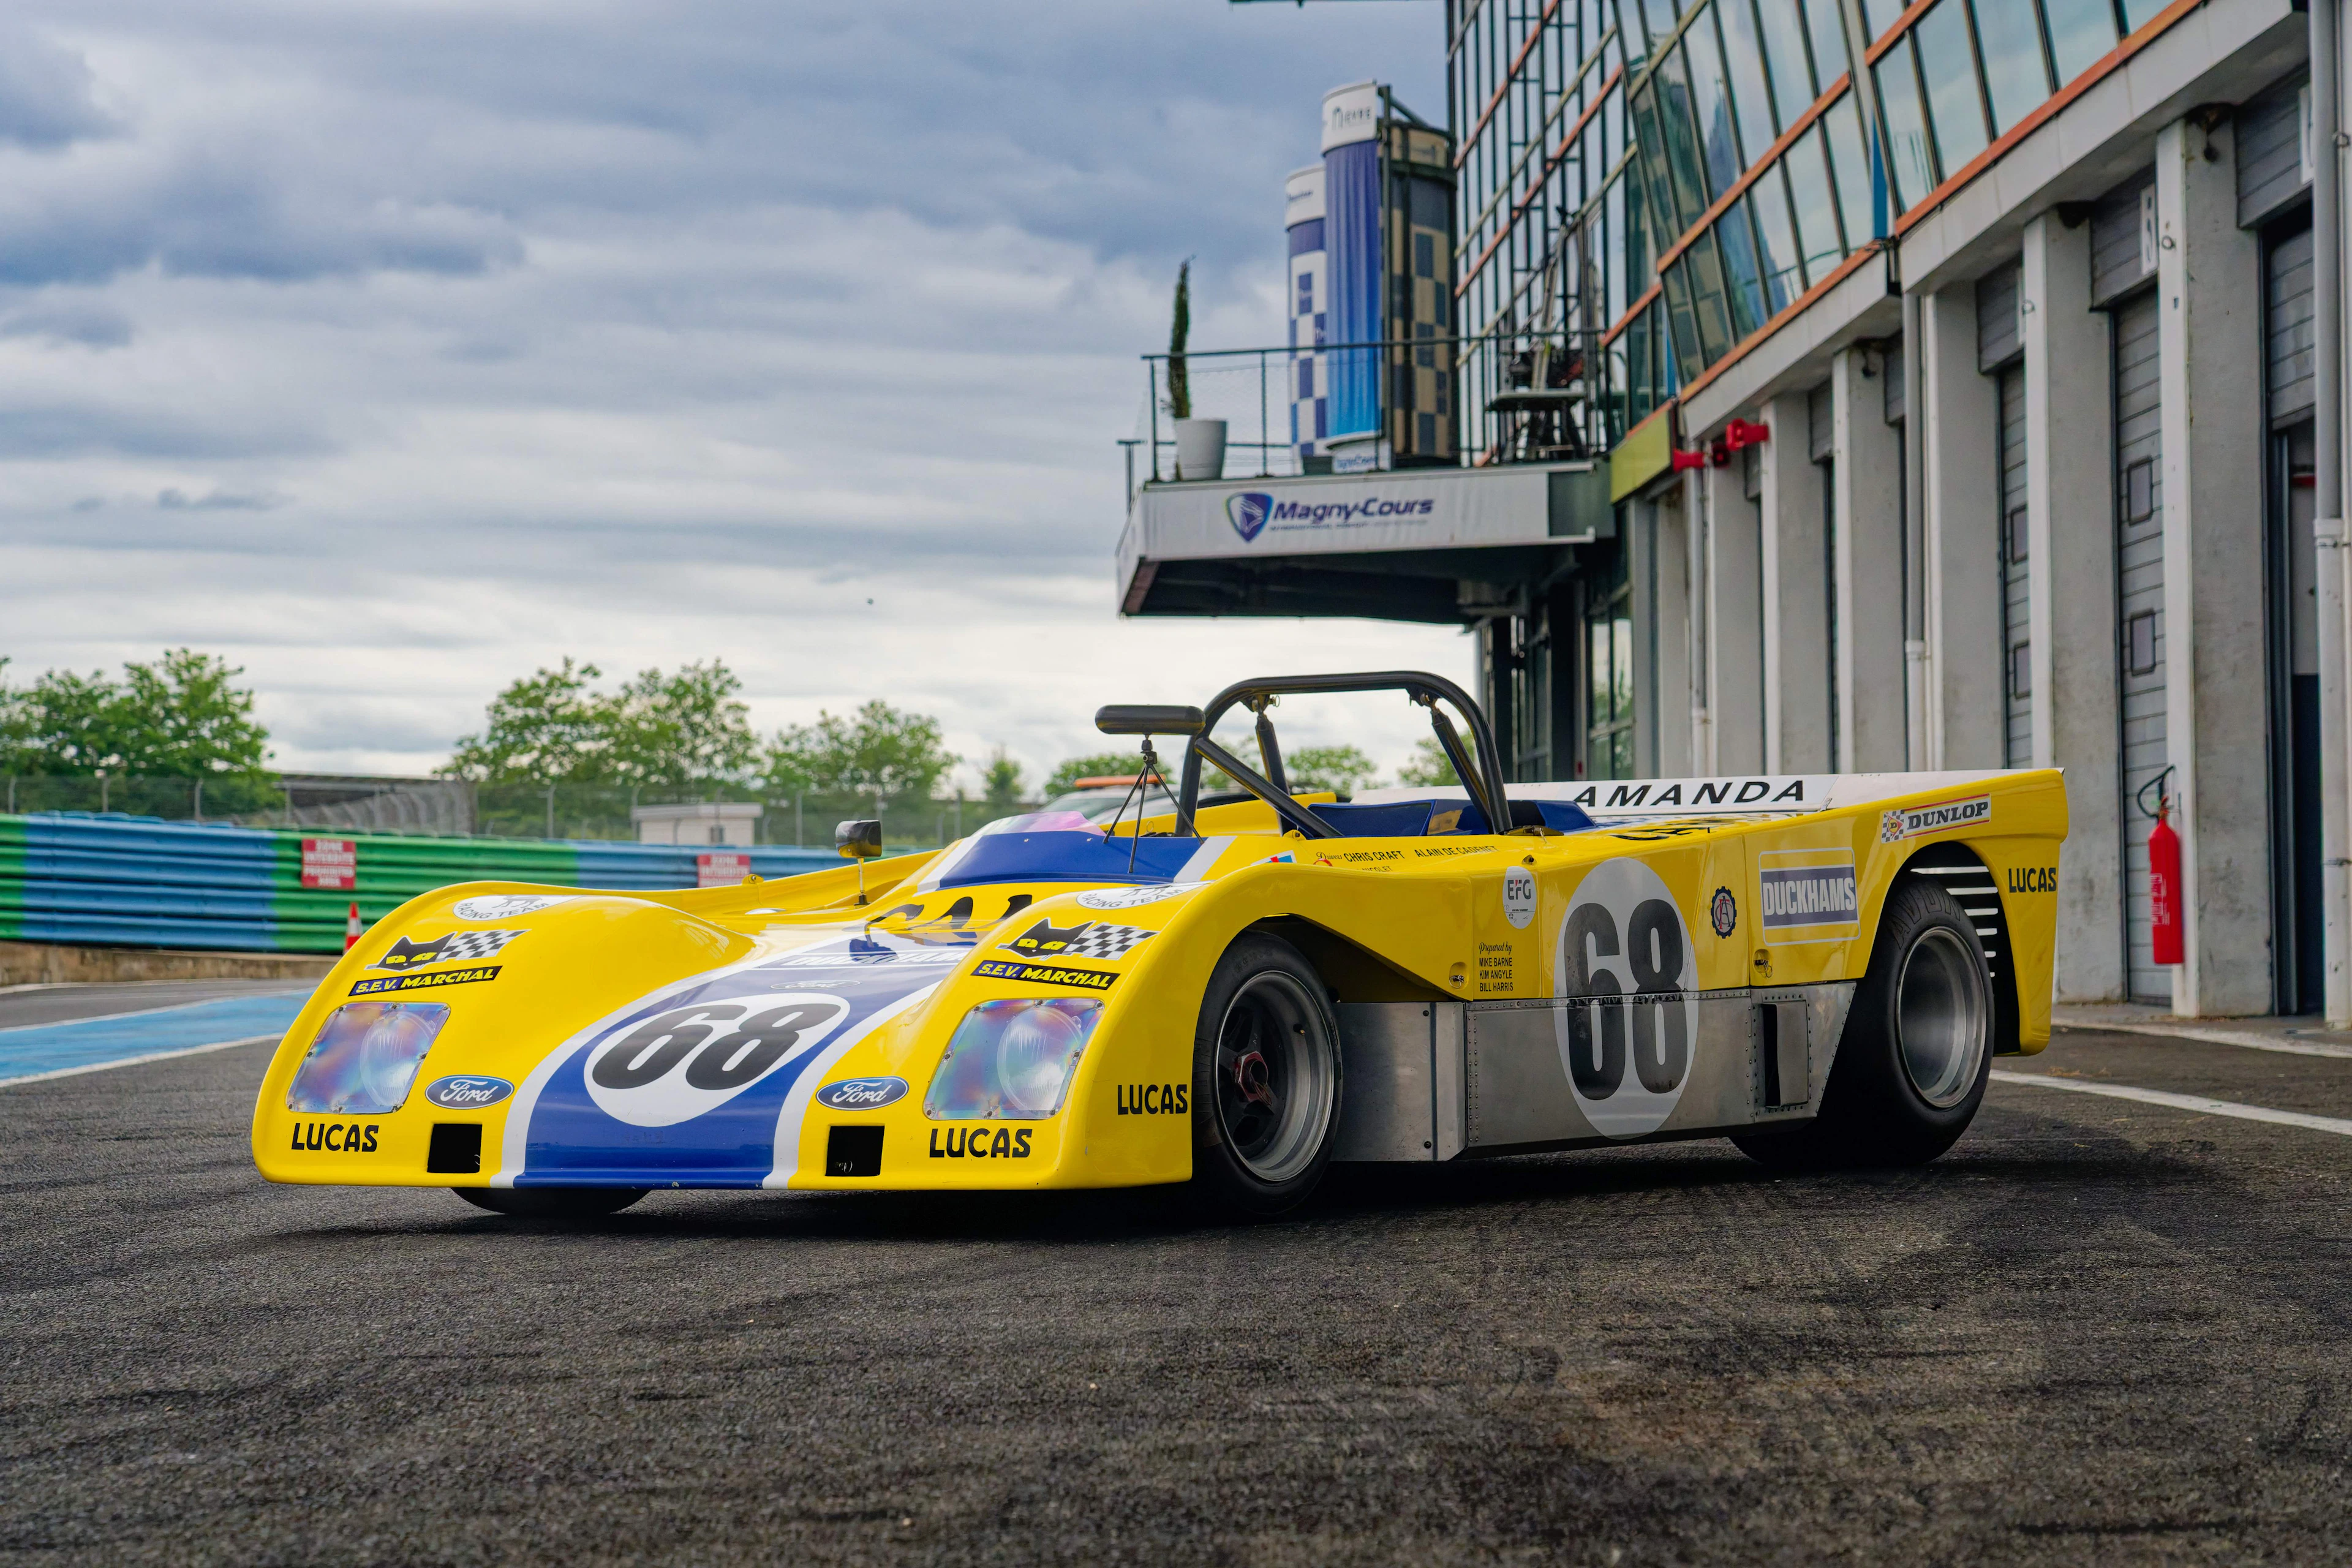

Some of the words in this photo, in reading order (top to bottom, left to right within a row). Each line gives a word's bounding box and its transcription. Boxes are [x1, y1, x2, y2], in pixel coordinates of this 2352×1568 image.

[1574, 780, 1804, 807] AMANDA
[1907, 801, 1989, 831] DUNLOP
[1316, 851, 1343, 861] Drivers
[1343, 852, 1374, 862] CHRIS
[1373, 850, 1405, 861] CRAFT
[1414, 848, 1444, 858] ALAIN
[1455, 846, 1500, 854] CADENET
[1507, 879, 1531, 900] EFG
[2008, 867, 2057, 894] LUCAS
[1082, 893, 1123, 908] RACING
[1129, 889, 1183, 906] TEAM
[1762, 877, 1856, 917] DUCKHAMS
[458, 902, 493, 919] RACING
[498, 902, 550, 918] TEAM
[780, 952, 967, 966] DUCKHAM
[1479, 941, 1505, 955] Prepared
[1505, 941, 1512, 956] by
[1479, 957, 1493, 967] MIKE
[1494, 957, 1512, 967] BARNE
[356, 979, 397, 993] S.E.V.
[399, 969, 494, 989] MARCHAL
[785, 980, 846, 989] Ford
[979, 963, 1020, 978] S.E.V.
[1020, 968, 1110, 987] MARCHAL
[1480, 970, 1490, 979] KIM
[1490, 970, 1513, 979] ANGYLE
[1480, 982, 1492, 992] BILL
[1493, 982, 1513, 992] HARRIS
[1563, 899, 1688, 1101] 68
[592, 1002, 842, 1090] 68
[440, 1079, 499, 1102] Ford
[832, 1081, 892, 1103] Ford
[1117, 1084, 1188, 1115] LUCAS
[291, 1122, 379, 1153] LUCAS
[929, 1128, 1033, 1158] LUCAS
